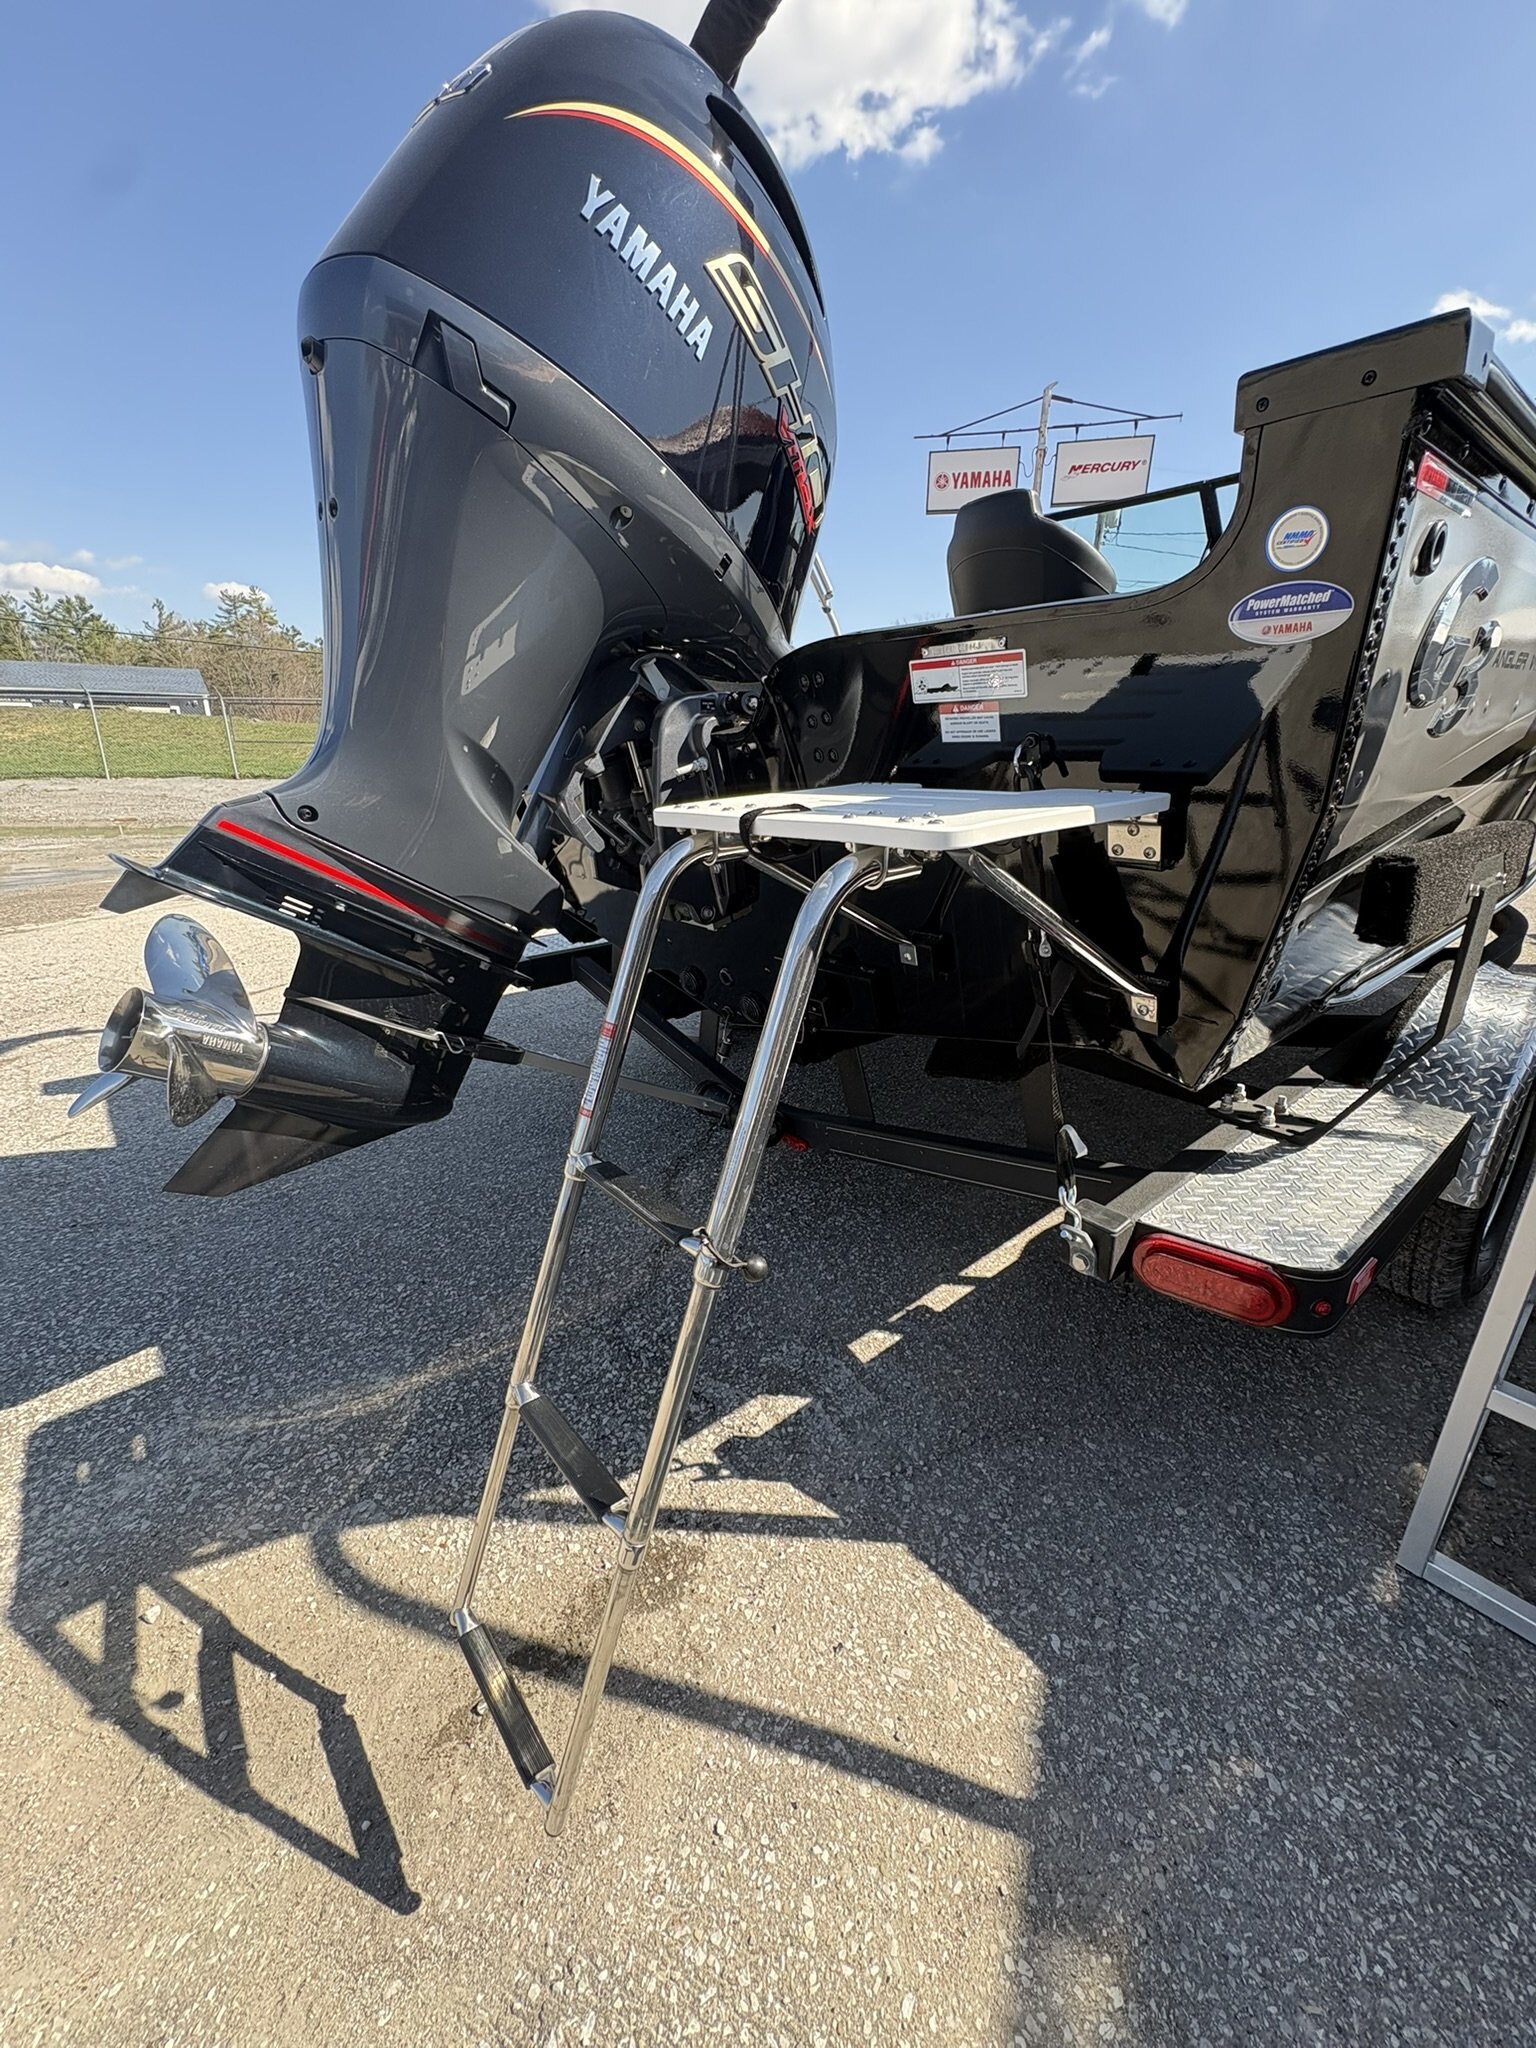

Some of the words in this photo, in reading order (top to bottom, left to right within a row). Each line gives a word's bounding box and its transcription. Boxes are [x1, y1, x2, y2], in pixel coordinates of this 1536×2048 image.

[579, 174, 715, 363] YAMAHA
[1067, 459, 1142, 476] MERCURY
[952, 469, 1012, 490] YAMAHA
[1246, 589, 1332, 611] PowerMatched
[1255, 608, 1281, 616] SYSTEM
[1283, 604, 1321, 613] WARRANTY
[1273, 621, 1313, 635] YAMAHA
[1492, 649, 1530, 670] ANGLER
[960, 702, 985, 711] DANGER
[202, 1034, 243, 1054] YAMAHA
